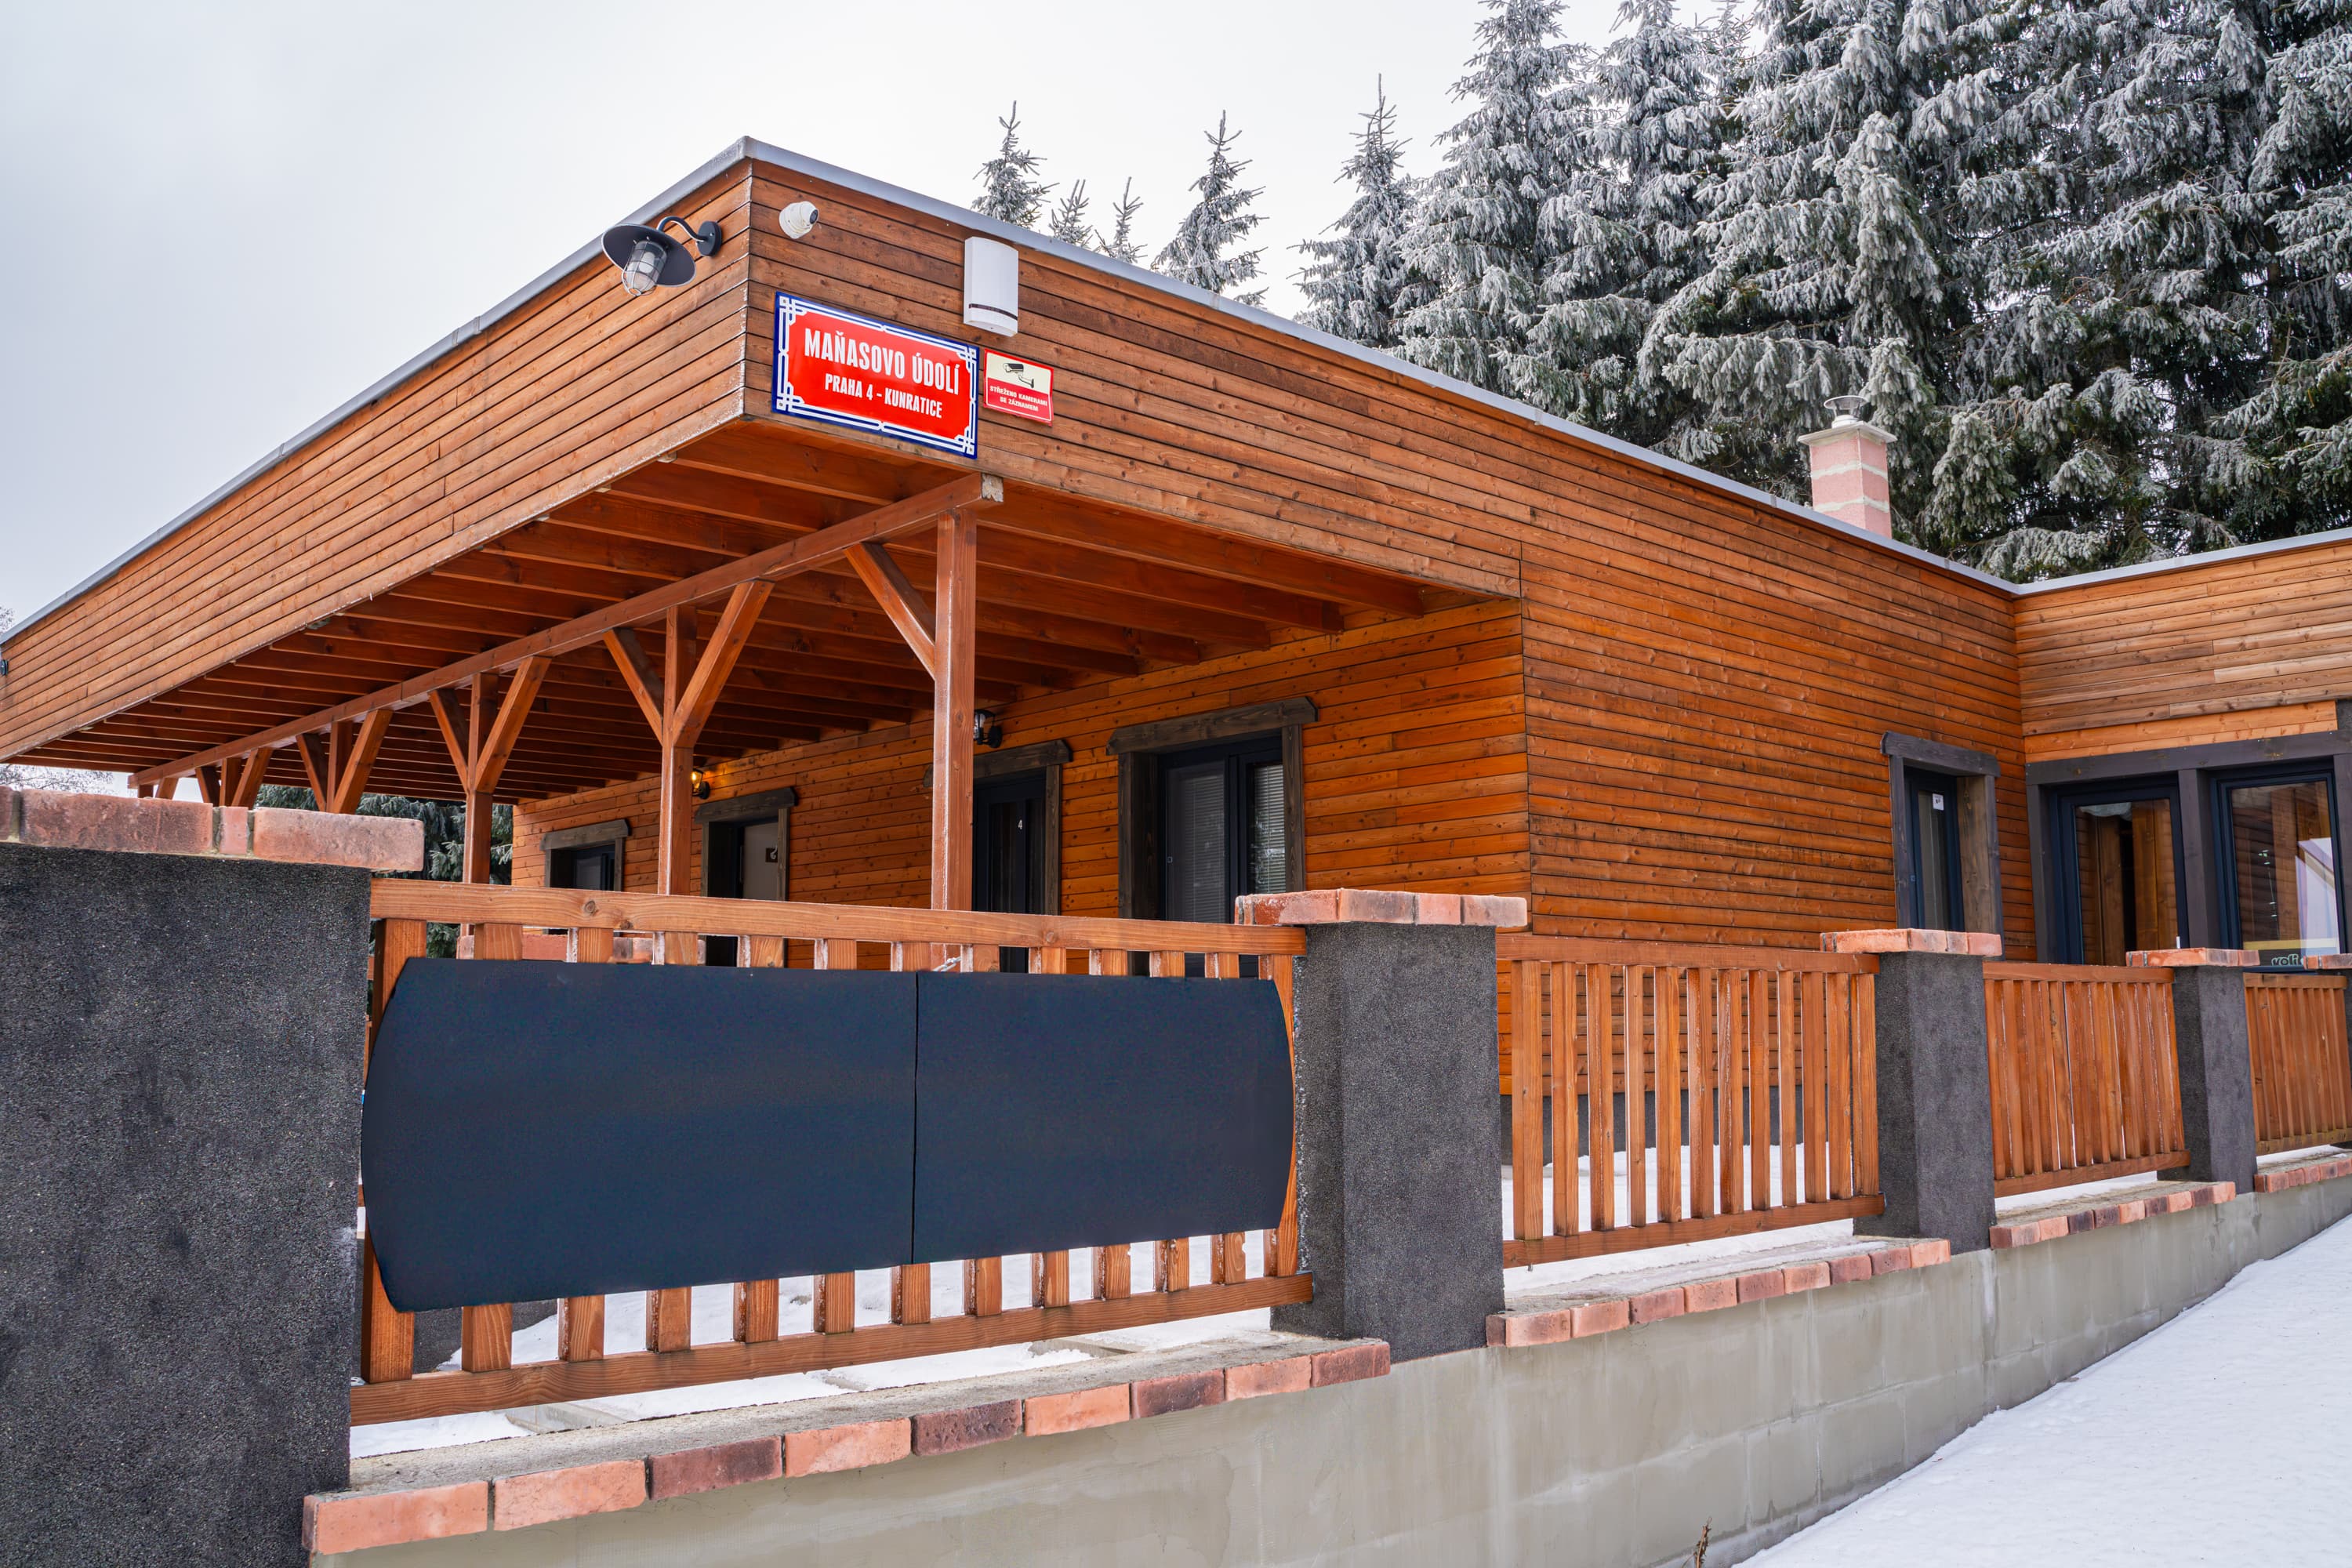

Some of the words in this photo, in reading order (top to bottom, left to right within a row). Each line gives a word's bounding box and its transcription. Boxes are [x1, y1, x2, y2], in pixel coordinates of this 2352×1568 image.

[804, 328, 905, 379] MAŇASOVO
[912, 352, 960, 395] ÚDOLÍ
[825, 373, 862, 398] PRAHA
[866, 384, 873, 401] 4
[884, 387, 942, 419] KUNRATICE
[1018, 393, 1047, 406] KAMERAMI
[1008, 397, 1039, 412] ZÁZNAMEM
[1018, 819, 1023, 830] 4
